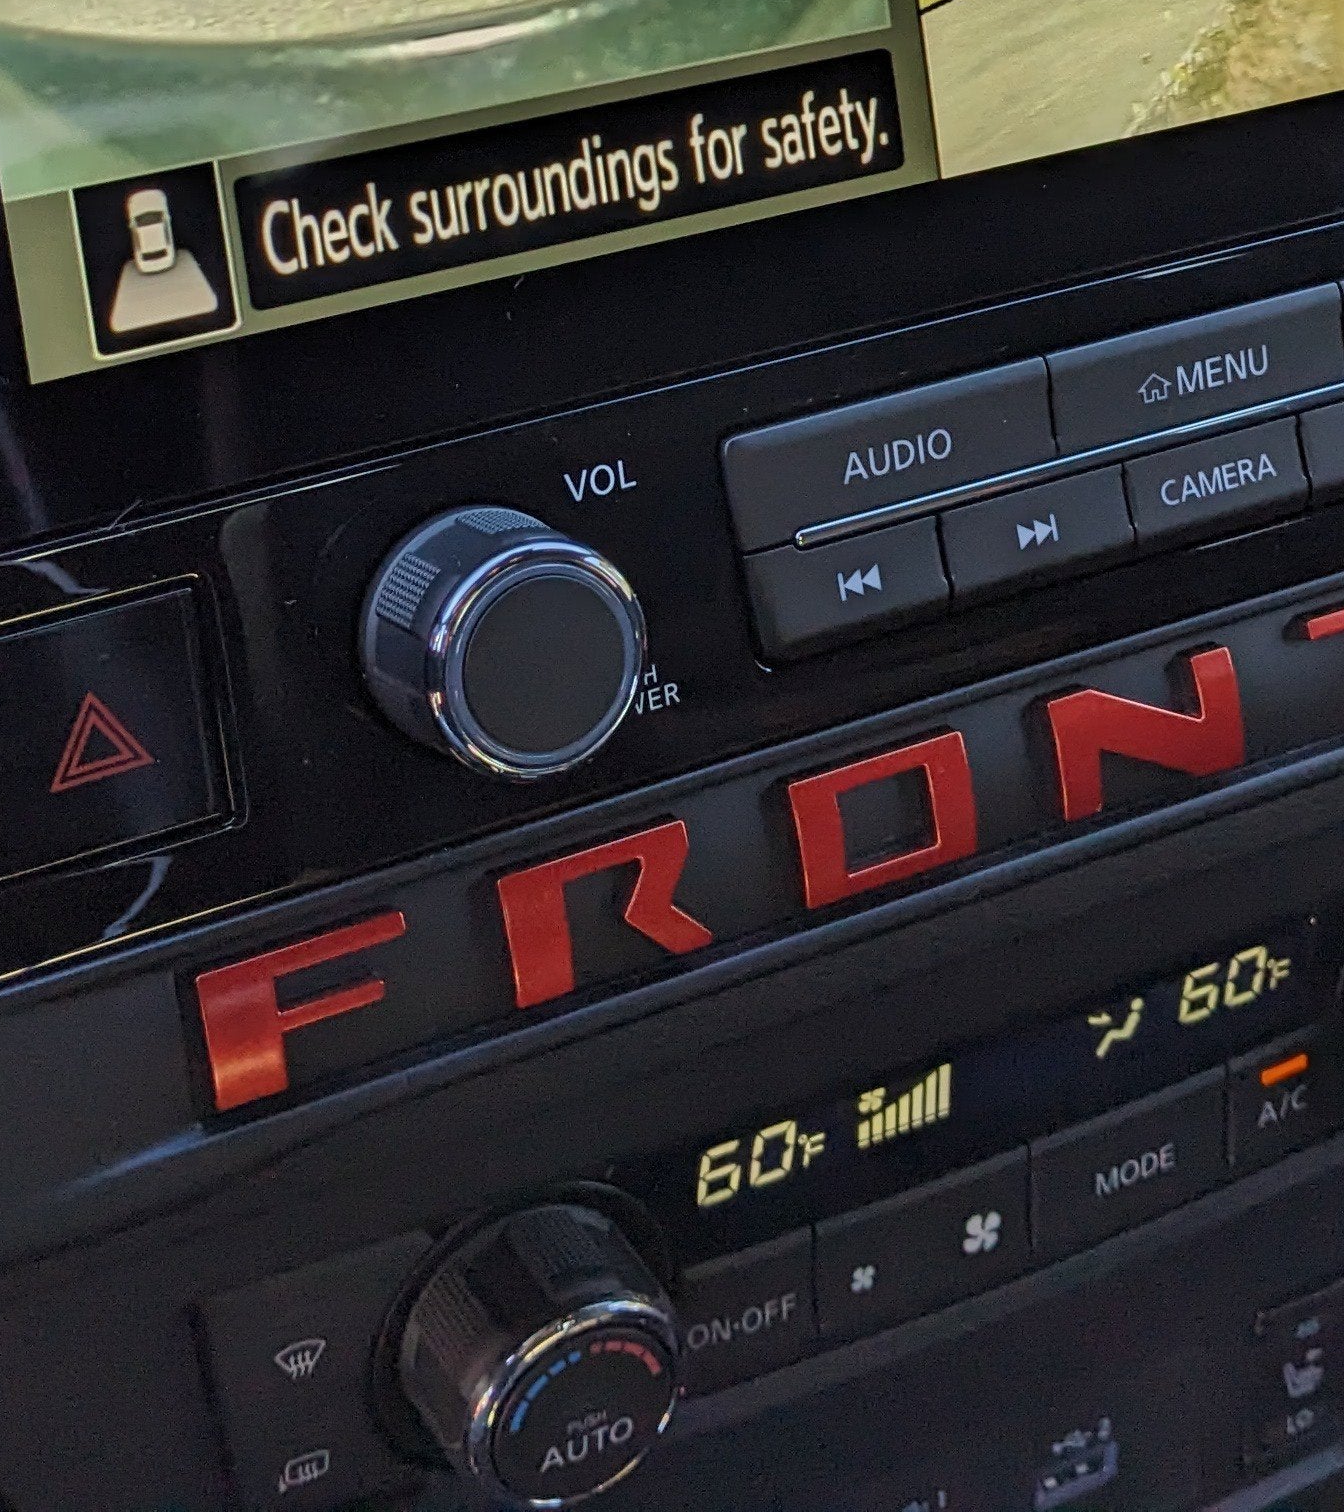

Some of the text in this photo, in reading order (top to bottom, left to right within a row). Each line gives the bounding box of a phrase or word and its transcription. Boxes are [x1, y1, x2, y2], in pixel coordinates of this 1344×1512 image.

[261, 88, 889, 276] Check surroundings for safety.
[1176, 344, 1269, 395] MENU
[563, 460, 637, 502] VOL
[843, 428, 953, 485] AUDIO
[1160, 453, 1277, 508] CAMERA
[1258, 1084, 1309, 1128] A/C
[1096, 1142, 1176, 1196] MODE
[539, 1415, 635, 1474] AUTO
